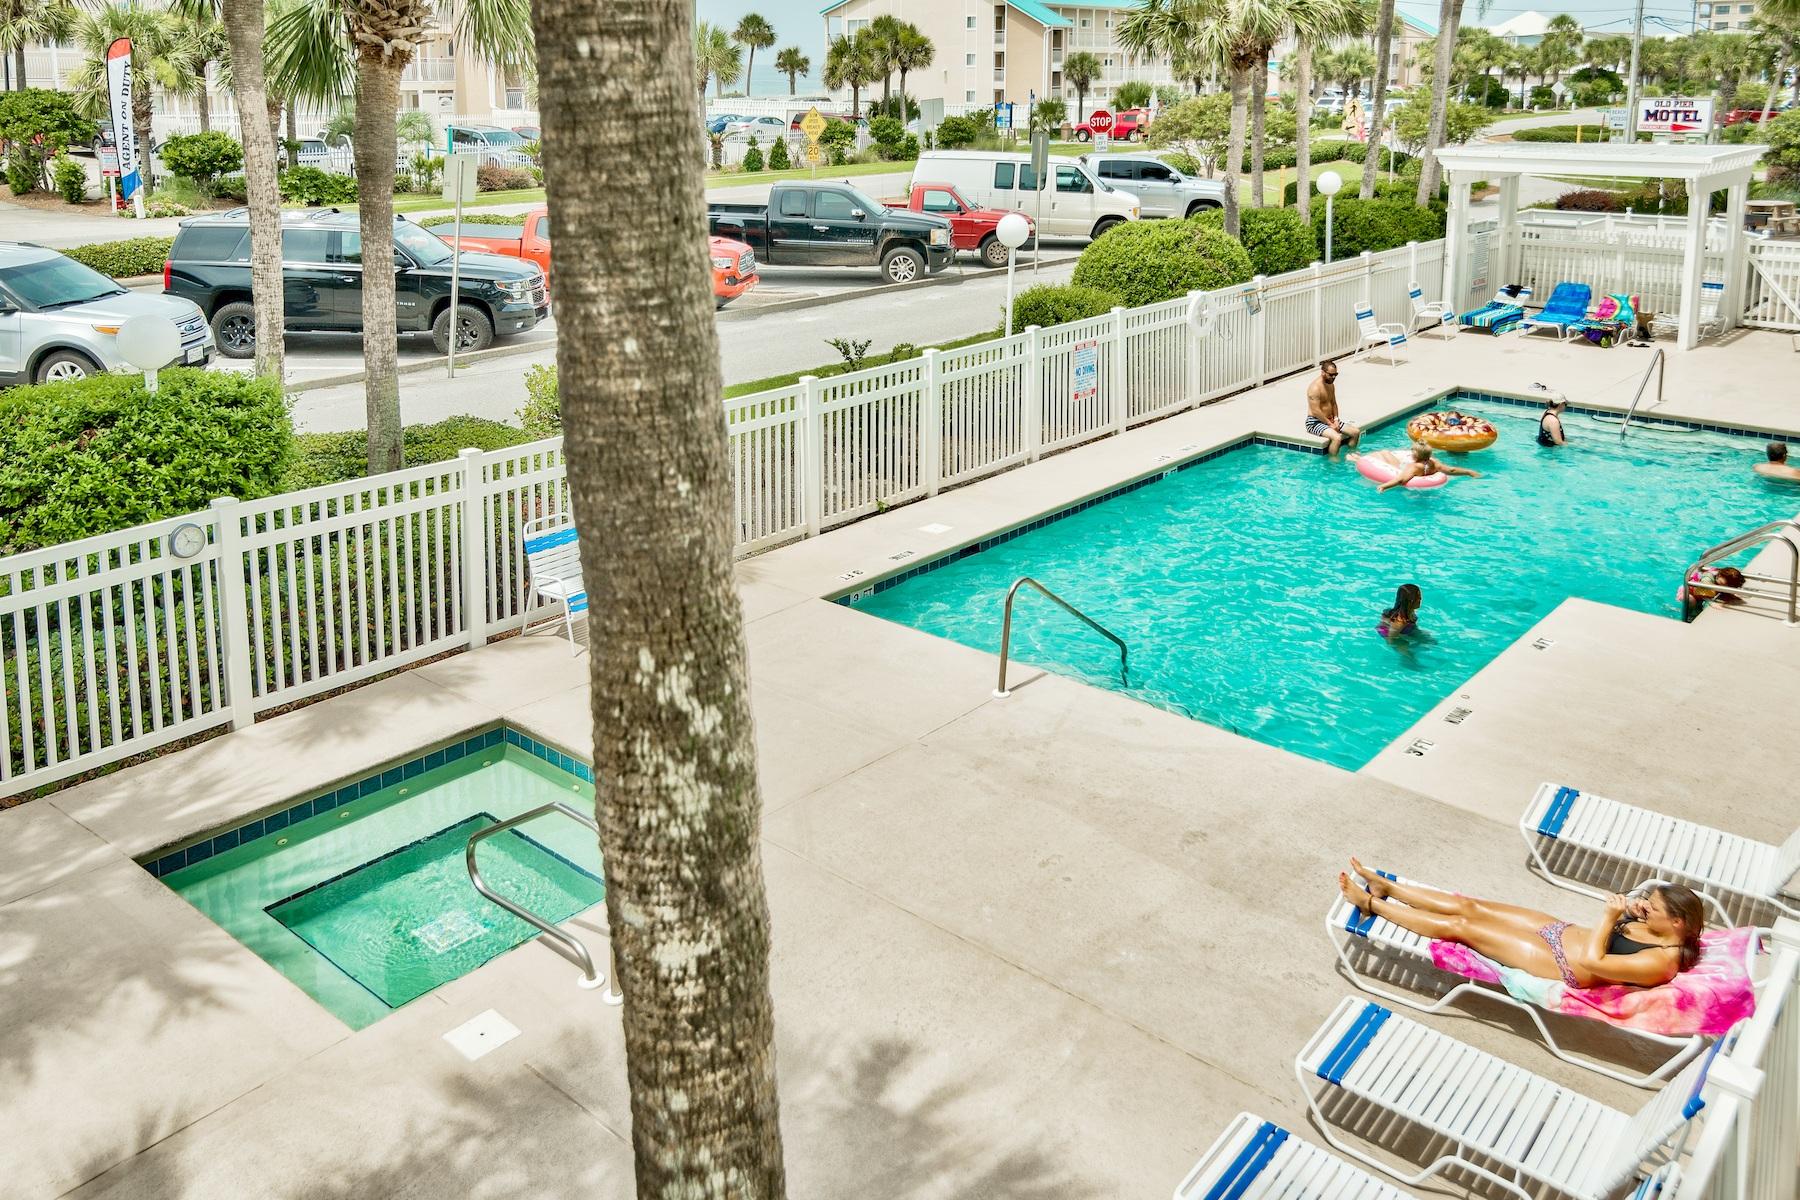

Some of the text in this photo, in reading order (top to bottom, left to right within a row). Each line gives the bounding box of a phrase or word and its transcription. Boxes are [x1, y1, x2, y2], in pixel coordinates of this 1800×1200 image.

[1654, 100, 1694, 108] OLD PIER
[121, 60, 131, 171] AGENT ON DUTY
[1643, 109, 1703, 122] MOTEL
[1090, 116, 1112, 127] STOP
[808, 146, 819, 156] 20
